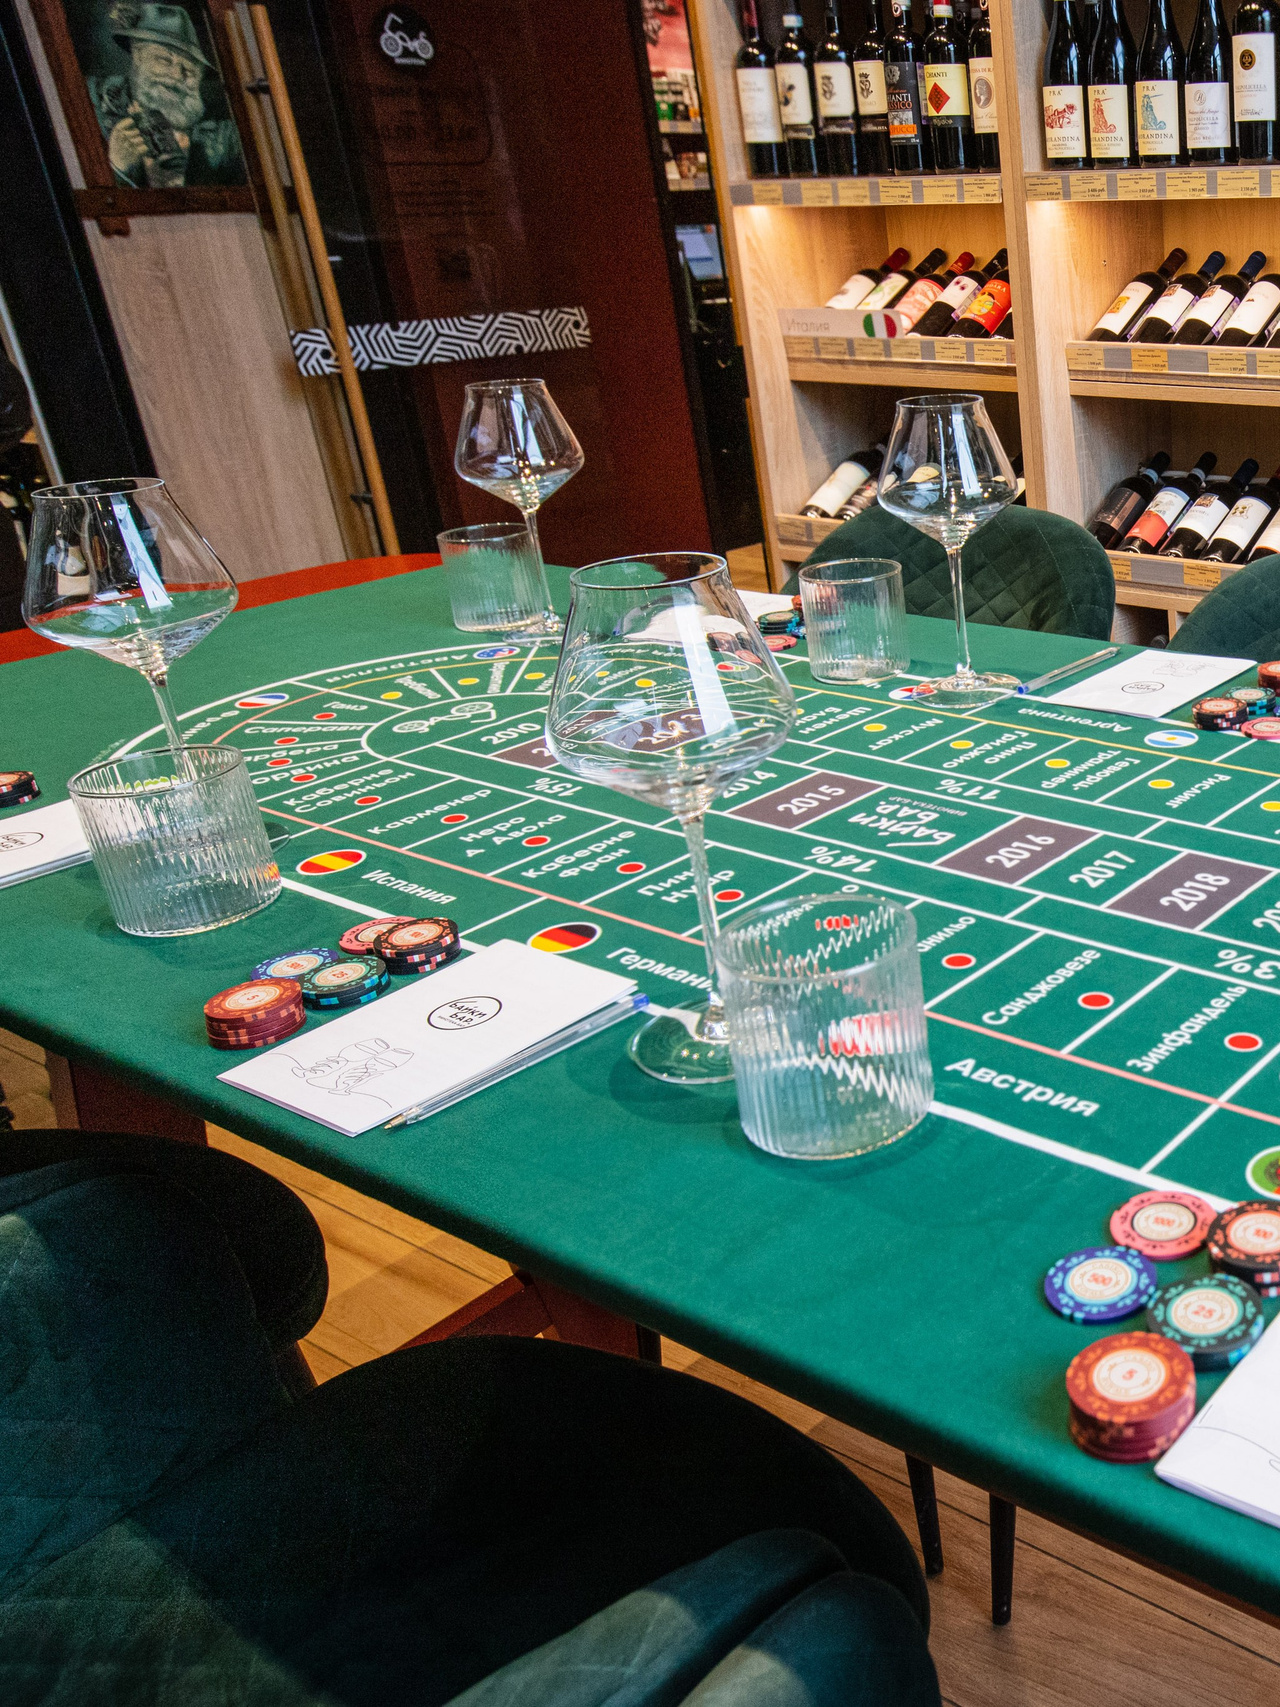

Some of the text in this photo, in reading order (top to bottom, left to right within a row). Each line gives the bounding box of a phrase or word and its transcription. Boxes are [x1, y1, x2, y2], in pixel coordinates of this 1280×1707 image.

[888, 93, 911, 102] HIANTI
[326, 654, 470, 683] Австралия
[481, 722, 542, 745] 2010
[799, 706, 872, 735] Шенен
[867, 718, 944, 752] Мускат
[1018, 708, 1132, 733] Аргентина
[243, 744, 339, 762] арбера
[942, 730, 1031, 770] Гриджио
[984, 741, 1037, 767] Пино
[251, 755, 360, 785] орвина
[1041, 749, 1122, 790] траминер
[1071, 756, 1141, 791] Гевюрц-
[283, 768, 395, 807] Каберне
[294, 772, 415, 813] Совиньон
[526, 777, 583, 798] 15%
[777, 785, 846, 815] 2015
[934, 778, 1002, 801] 11%
[1165, 773, 1232, 809] Рислинг
[367, 788, 492, 835] Карменер
[458, 816, 526, 843] Неро
[492, 814, 567, 846] Авола
[521, 829, 636, 879] Каберне
[558, 848, 632, 880] Фран
[802, 845, 878, 873] 14%
[986, 834, 1056, 869] 2016
[637, 868, 698, 897] Пин
[1069, 851, 1136, 889] 2017
[361, 868, 457, 905] Испания
[1160, 871, 1231, 913] 2018
[606, 946, 715, 992] Германи
[981, 948, 1101, 1027] Санджовезе
[1126, 984, 1248, 1073] Зинфандель
[944, 1057, 1101, 1118] Австрия
[1087, 1273, 1113, 1287] 500
[1191, 1304, 1217, 1320] 25
[1121, 1367, 1139, 1381] 5
